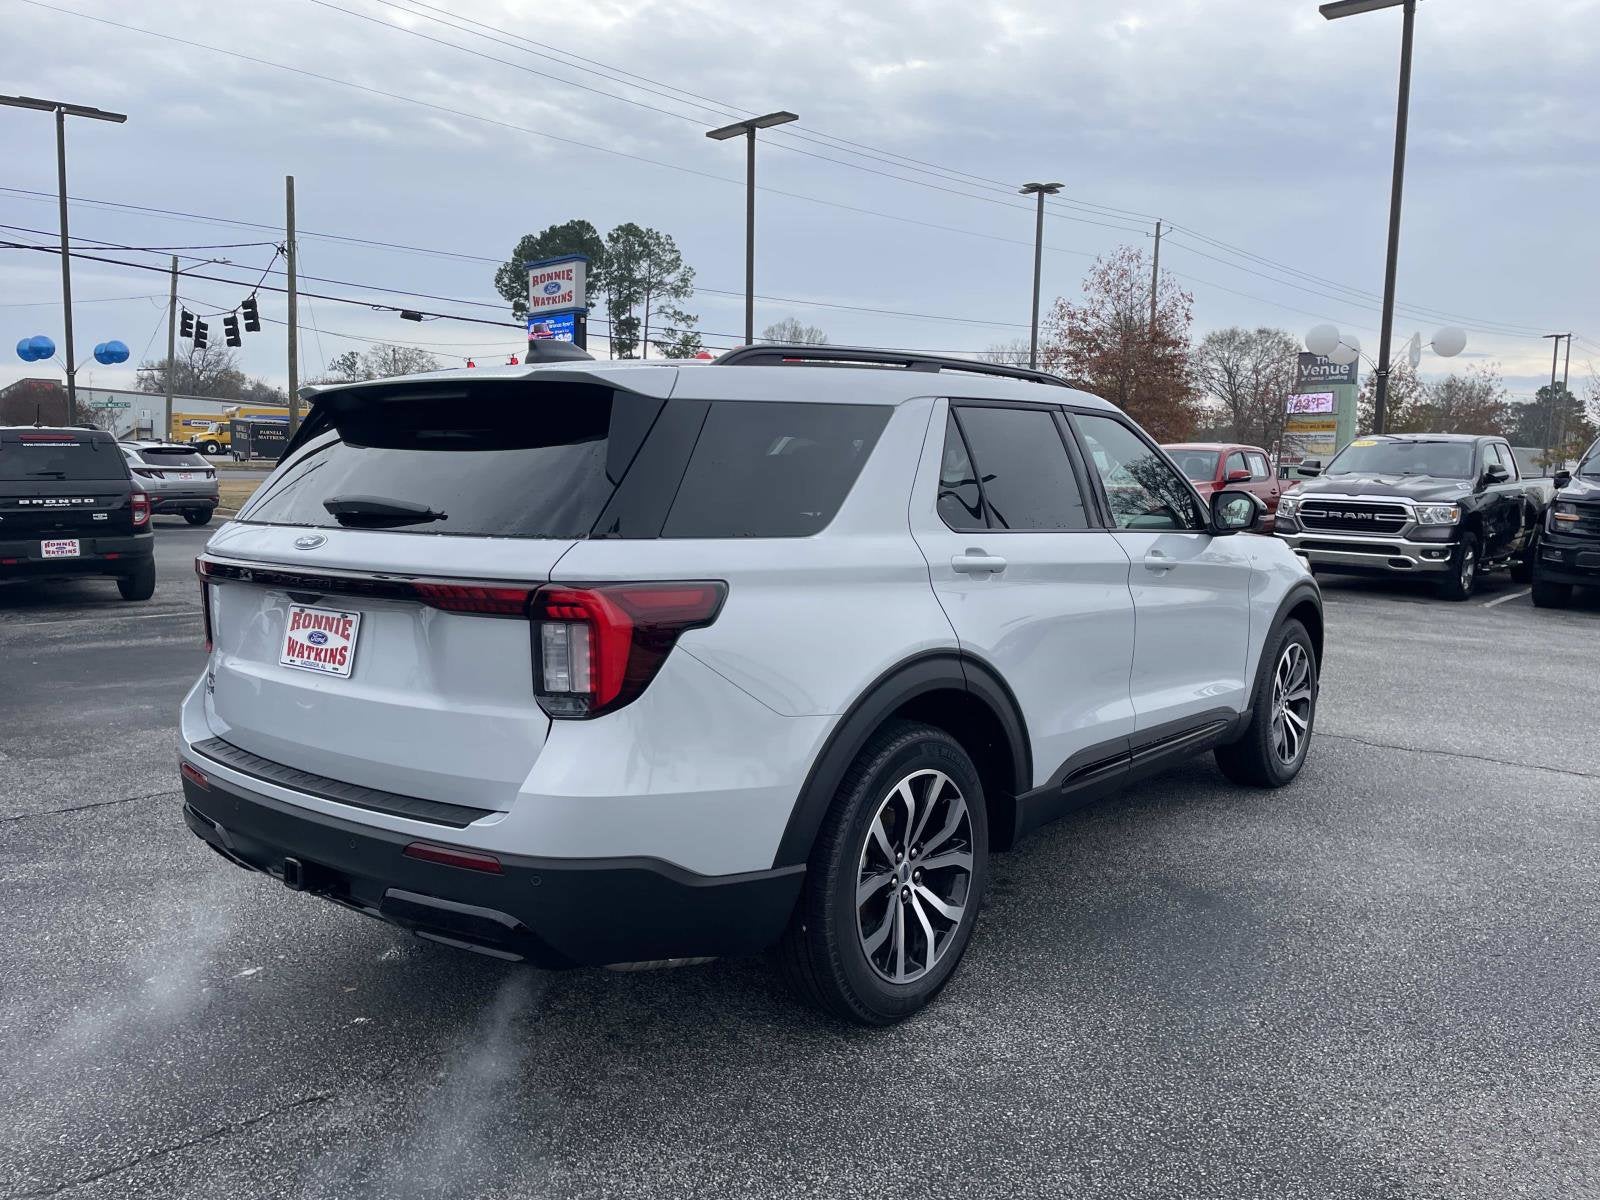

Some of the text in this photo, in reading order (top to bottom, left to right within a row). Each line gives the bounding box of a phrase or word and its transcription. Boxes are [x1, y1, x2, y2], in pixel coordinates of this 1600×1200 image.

[532, 269, 573, 287] RONNIE
[532, 290, 573, 307] WATKINS
[1301, 365, 1350, 377] Venue
[1328, 511, 1373, 520] RAM
[44, 541, 77, 549] RONNIE
[289, 611, 353, 641] RONNIE
[286, 635, 349, 667] WATKINS
